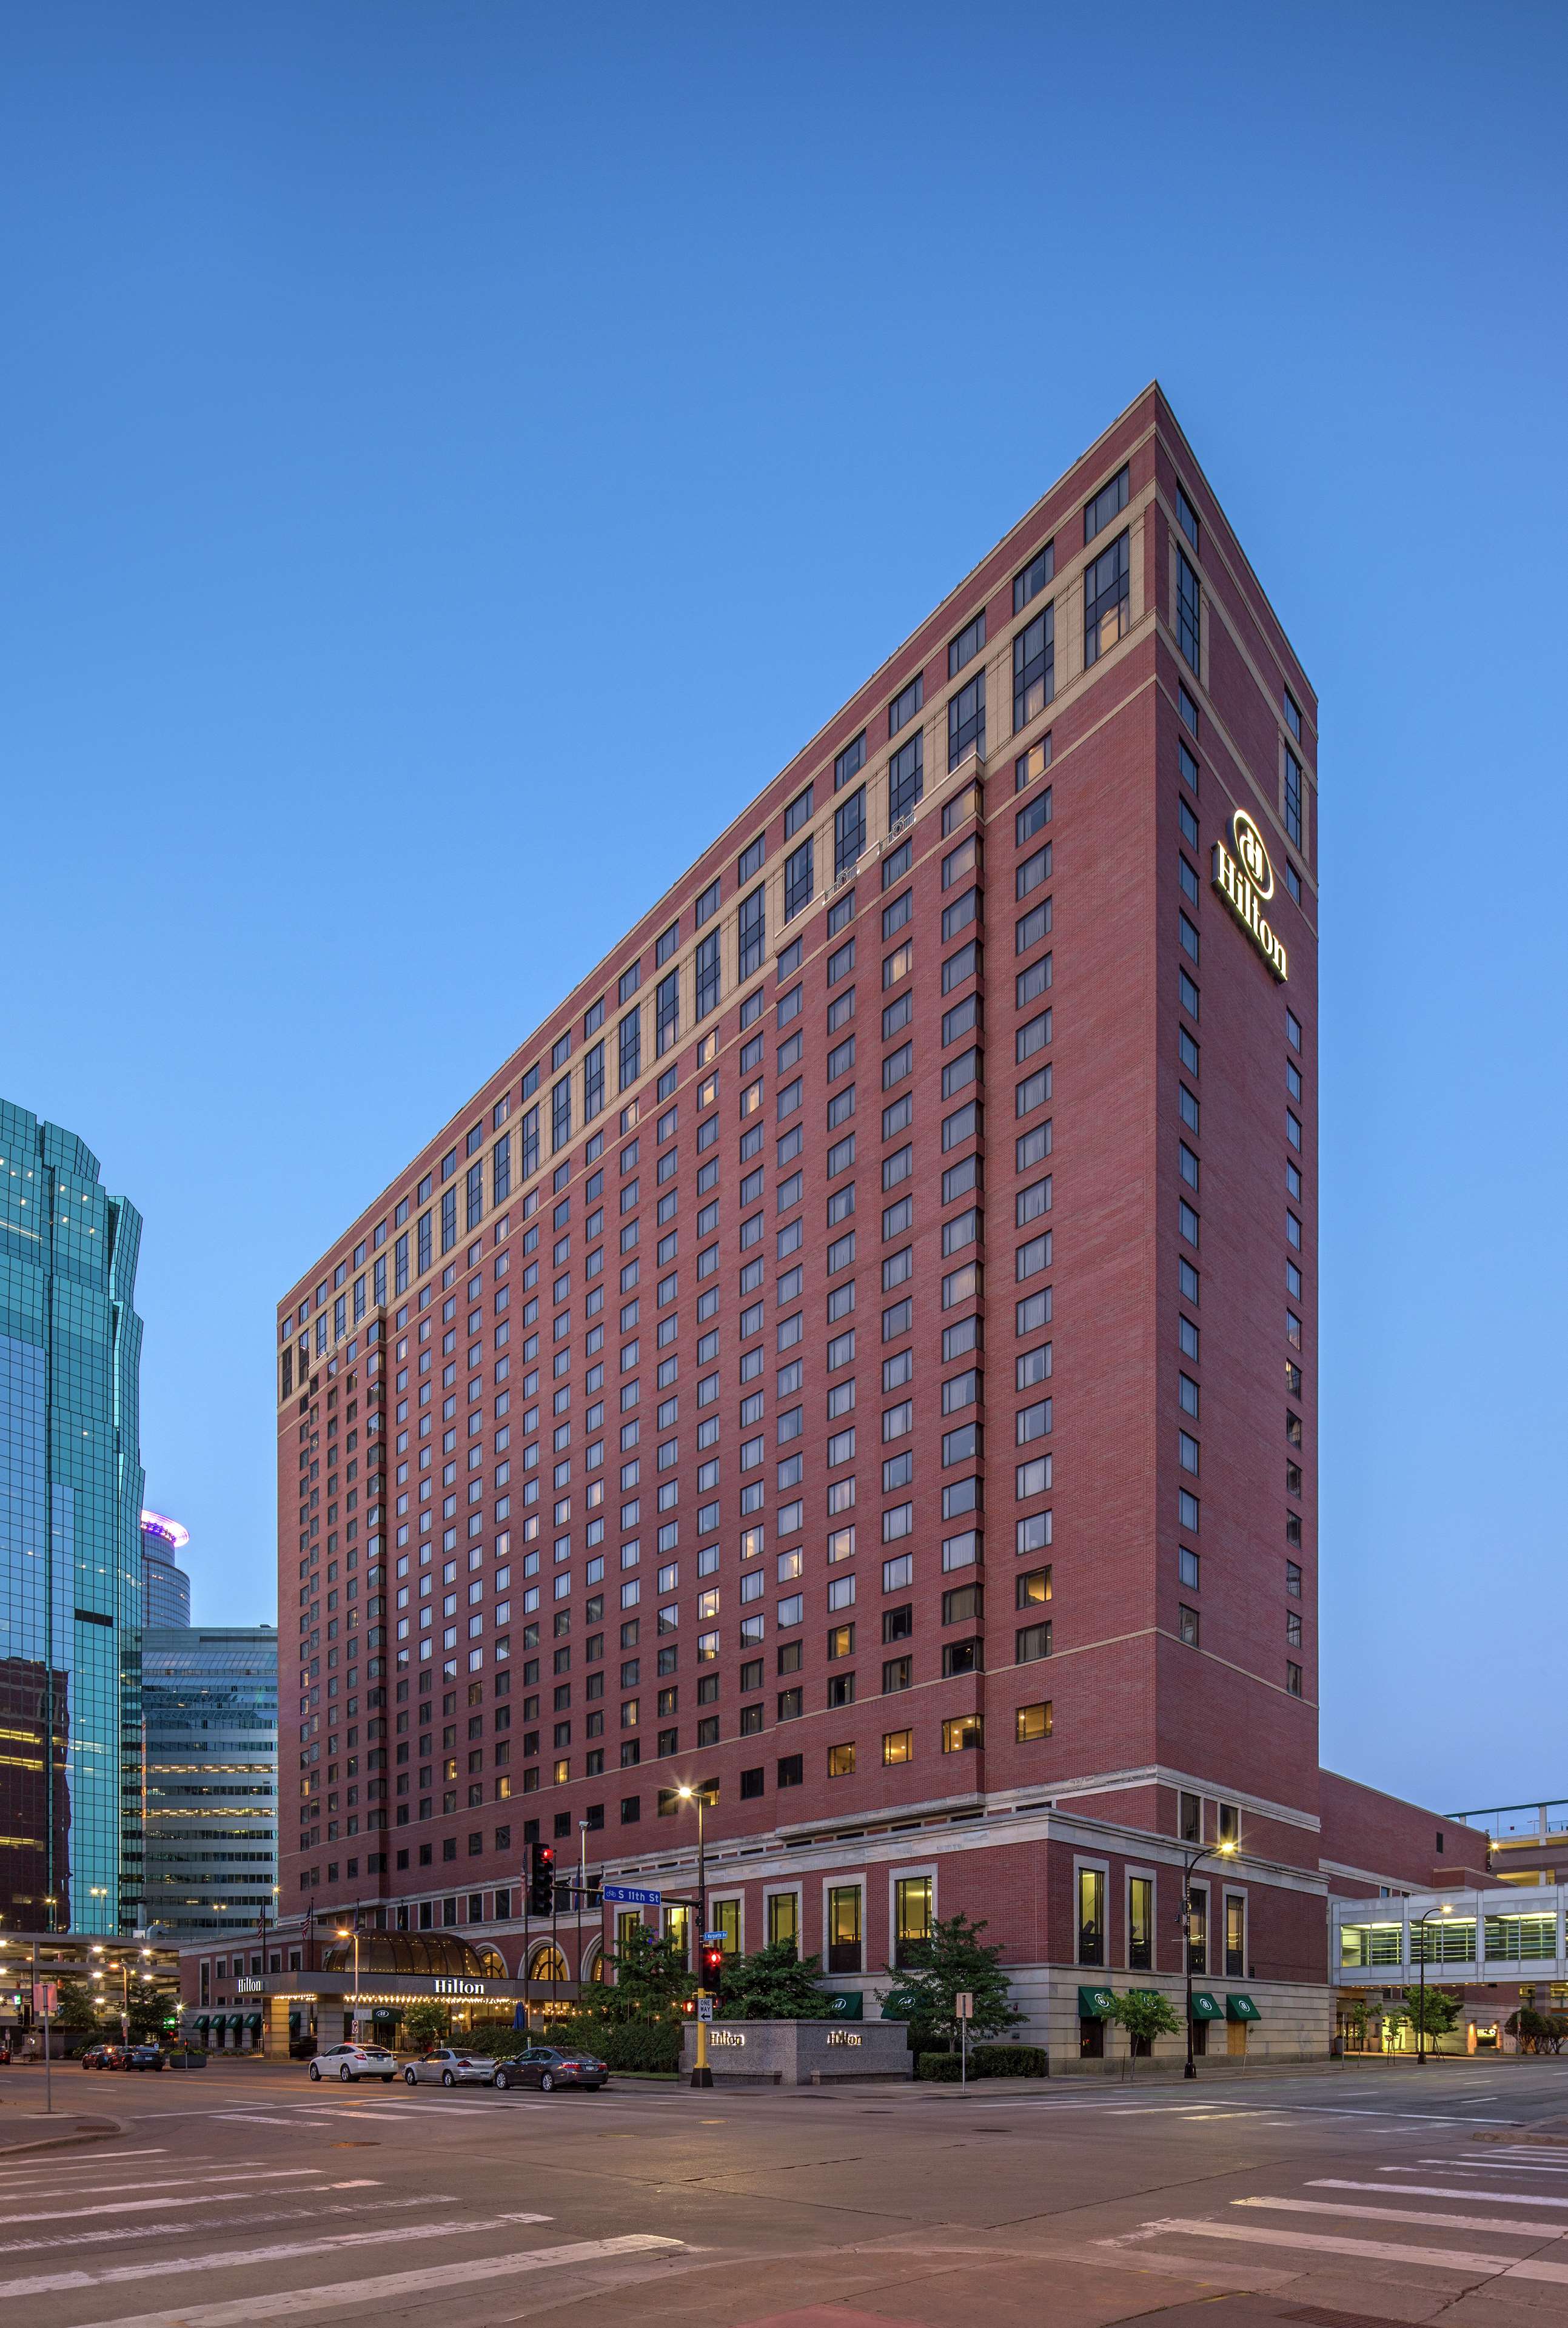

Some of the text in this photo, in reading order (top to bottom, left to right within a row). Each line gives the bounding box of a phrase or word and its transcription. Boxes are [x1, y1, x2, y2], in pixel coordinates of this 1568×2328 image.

[1217, 840, 1288, 981] Hilton
[618, 1890, 660, 1903] S 11th St
[238, 1977, 261, 1992] Hilton
[434, 1979, 484, 1994] Hilton
[709, 2031, 745, 2045] Hilton
[828, 2031, 863, 2045] Hilton
